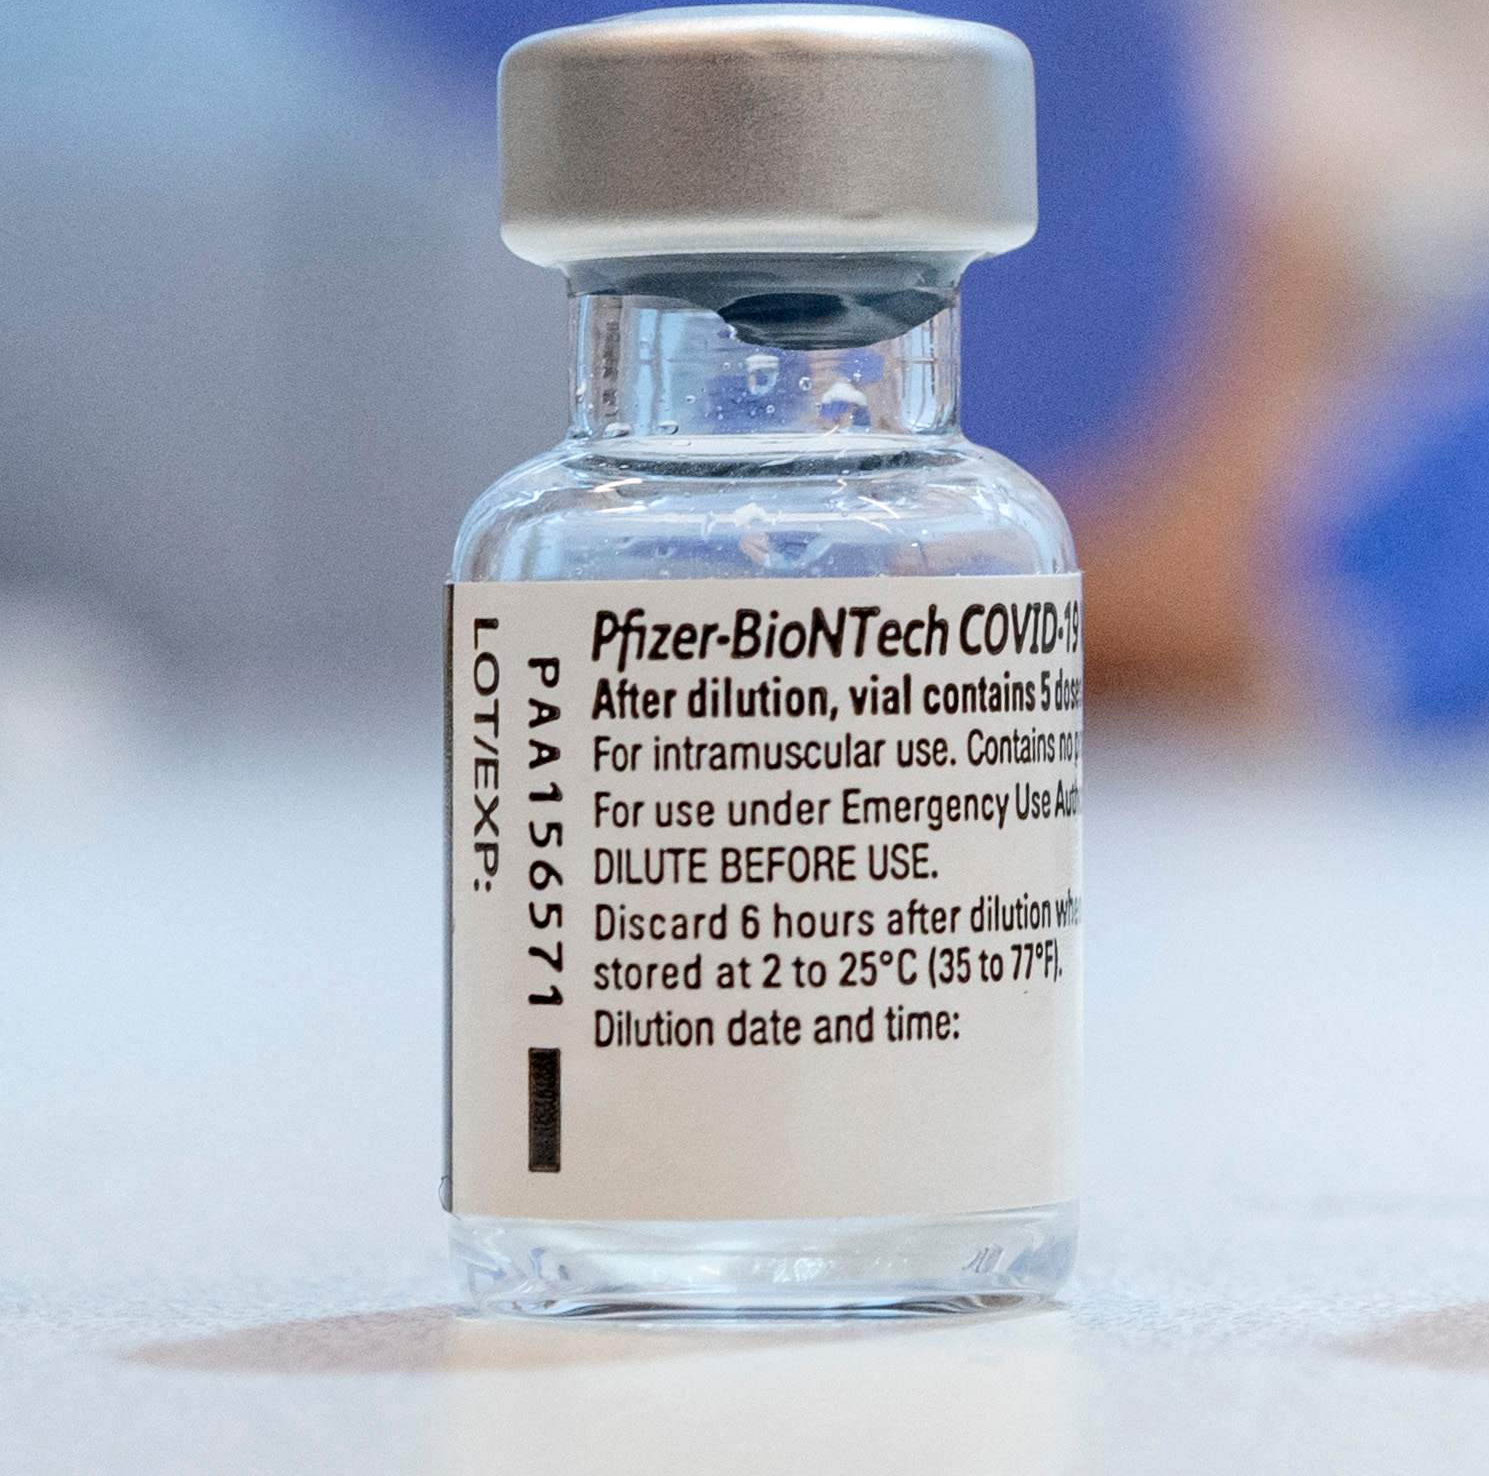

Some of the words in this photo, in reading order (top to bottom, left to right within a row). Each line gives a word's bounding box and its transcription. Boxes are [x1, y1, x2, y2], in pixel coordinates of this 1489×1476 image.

[590, 602, 950, 674] Pfizer-BioNTech
[958, 600, 1079, 657] COVID-19
[590, 677, 678, 721] After
[687, 675, 839, 723] dilution,
[848, 672, 913, 717] vial
[922, 670, 1037, 716] contains
[1040, 670, 1052, 712] 5
[473, 617, 500, 893] LOT/EXP:
[593, 734, 644, 773] For
[653, 731, 887, 772] intramuscular
[896, 736, 957, 769] use.
[966, 726, 1056, 767] Contains
[1059, 730, 1073, 762] no
[527, 656, 565, 1007] PAA156571
[593, 790, 646, 829] For
[654, 799, 716, 829] use
[727, 789, 832, 828] under
[841, 787, 1010, 832] Emergency
[1014, 781, 1052, 821] Use
[593, 846, 708, 886] DILUTE
[720, 844, 858, 885] BEFORE
[867, 841, 939, 882] USE.
[594, 902, 728, 942] Discard
[740, 903, 761, 941] 6
[772, 901, 875, 940] hours
[886, 897, 962, 937] after
[969, 892, 1052, 934] dilution
[593, 952, 703, 992] stored
[716, 956, 752, 990] at
[761, 952, 783, 990] 2
[791, 956, 828, 989] to
[838, 947, 918, 988] 25°C
[927, 945, 972, 990] (35
[977, 949, 1004, 983] to
[1010, 938, 1063, 982] 77°F).
[593, 1008, 715, 1049] Dilution
[726, 1008, 802, 1048] date
[813, 1005, 875, 1046] and
[884, 1004, 960, 1043] time:
